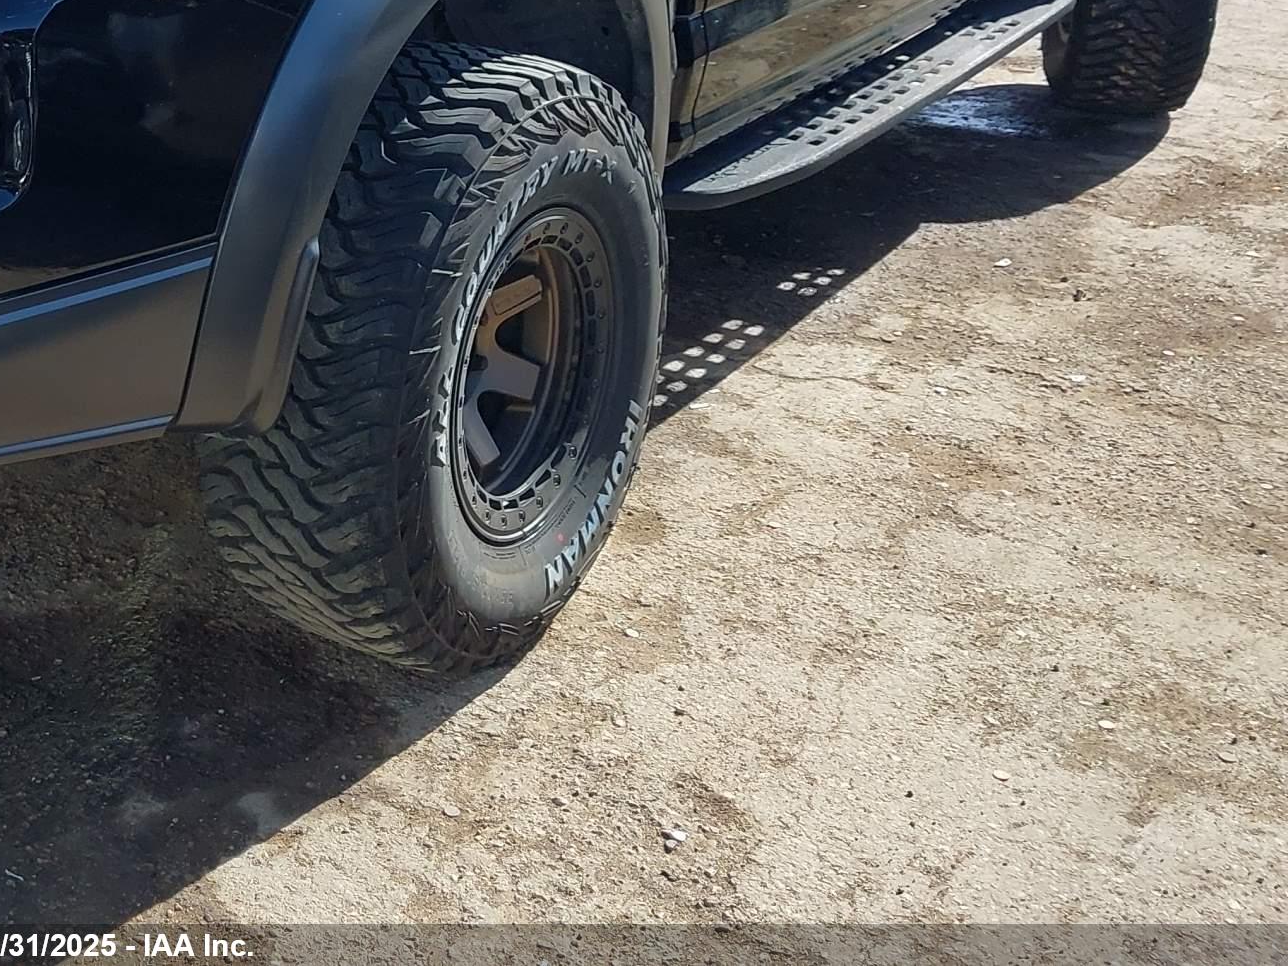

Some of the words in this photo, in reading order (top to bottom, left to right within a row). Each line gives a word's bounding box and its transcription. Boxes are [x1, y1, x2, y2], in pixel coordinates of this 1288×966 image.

[432, 365, 453, 466] ALL
[453, 155, 559, 345] COUNTRY
[544, 399, 643, 601] IRONMAN
